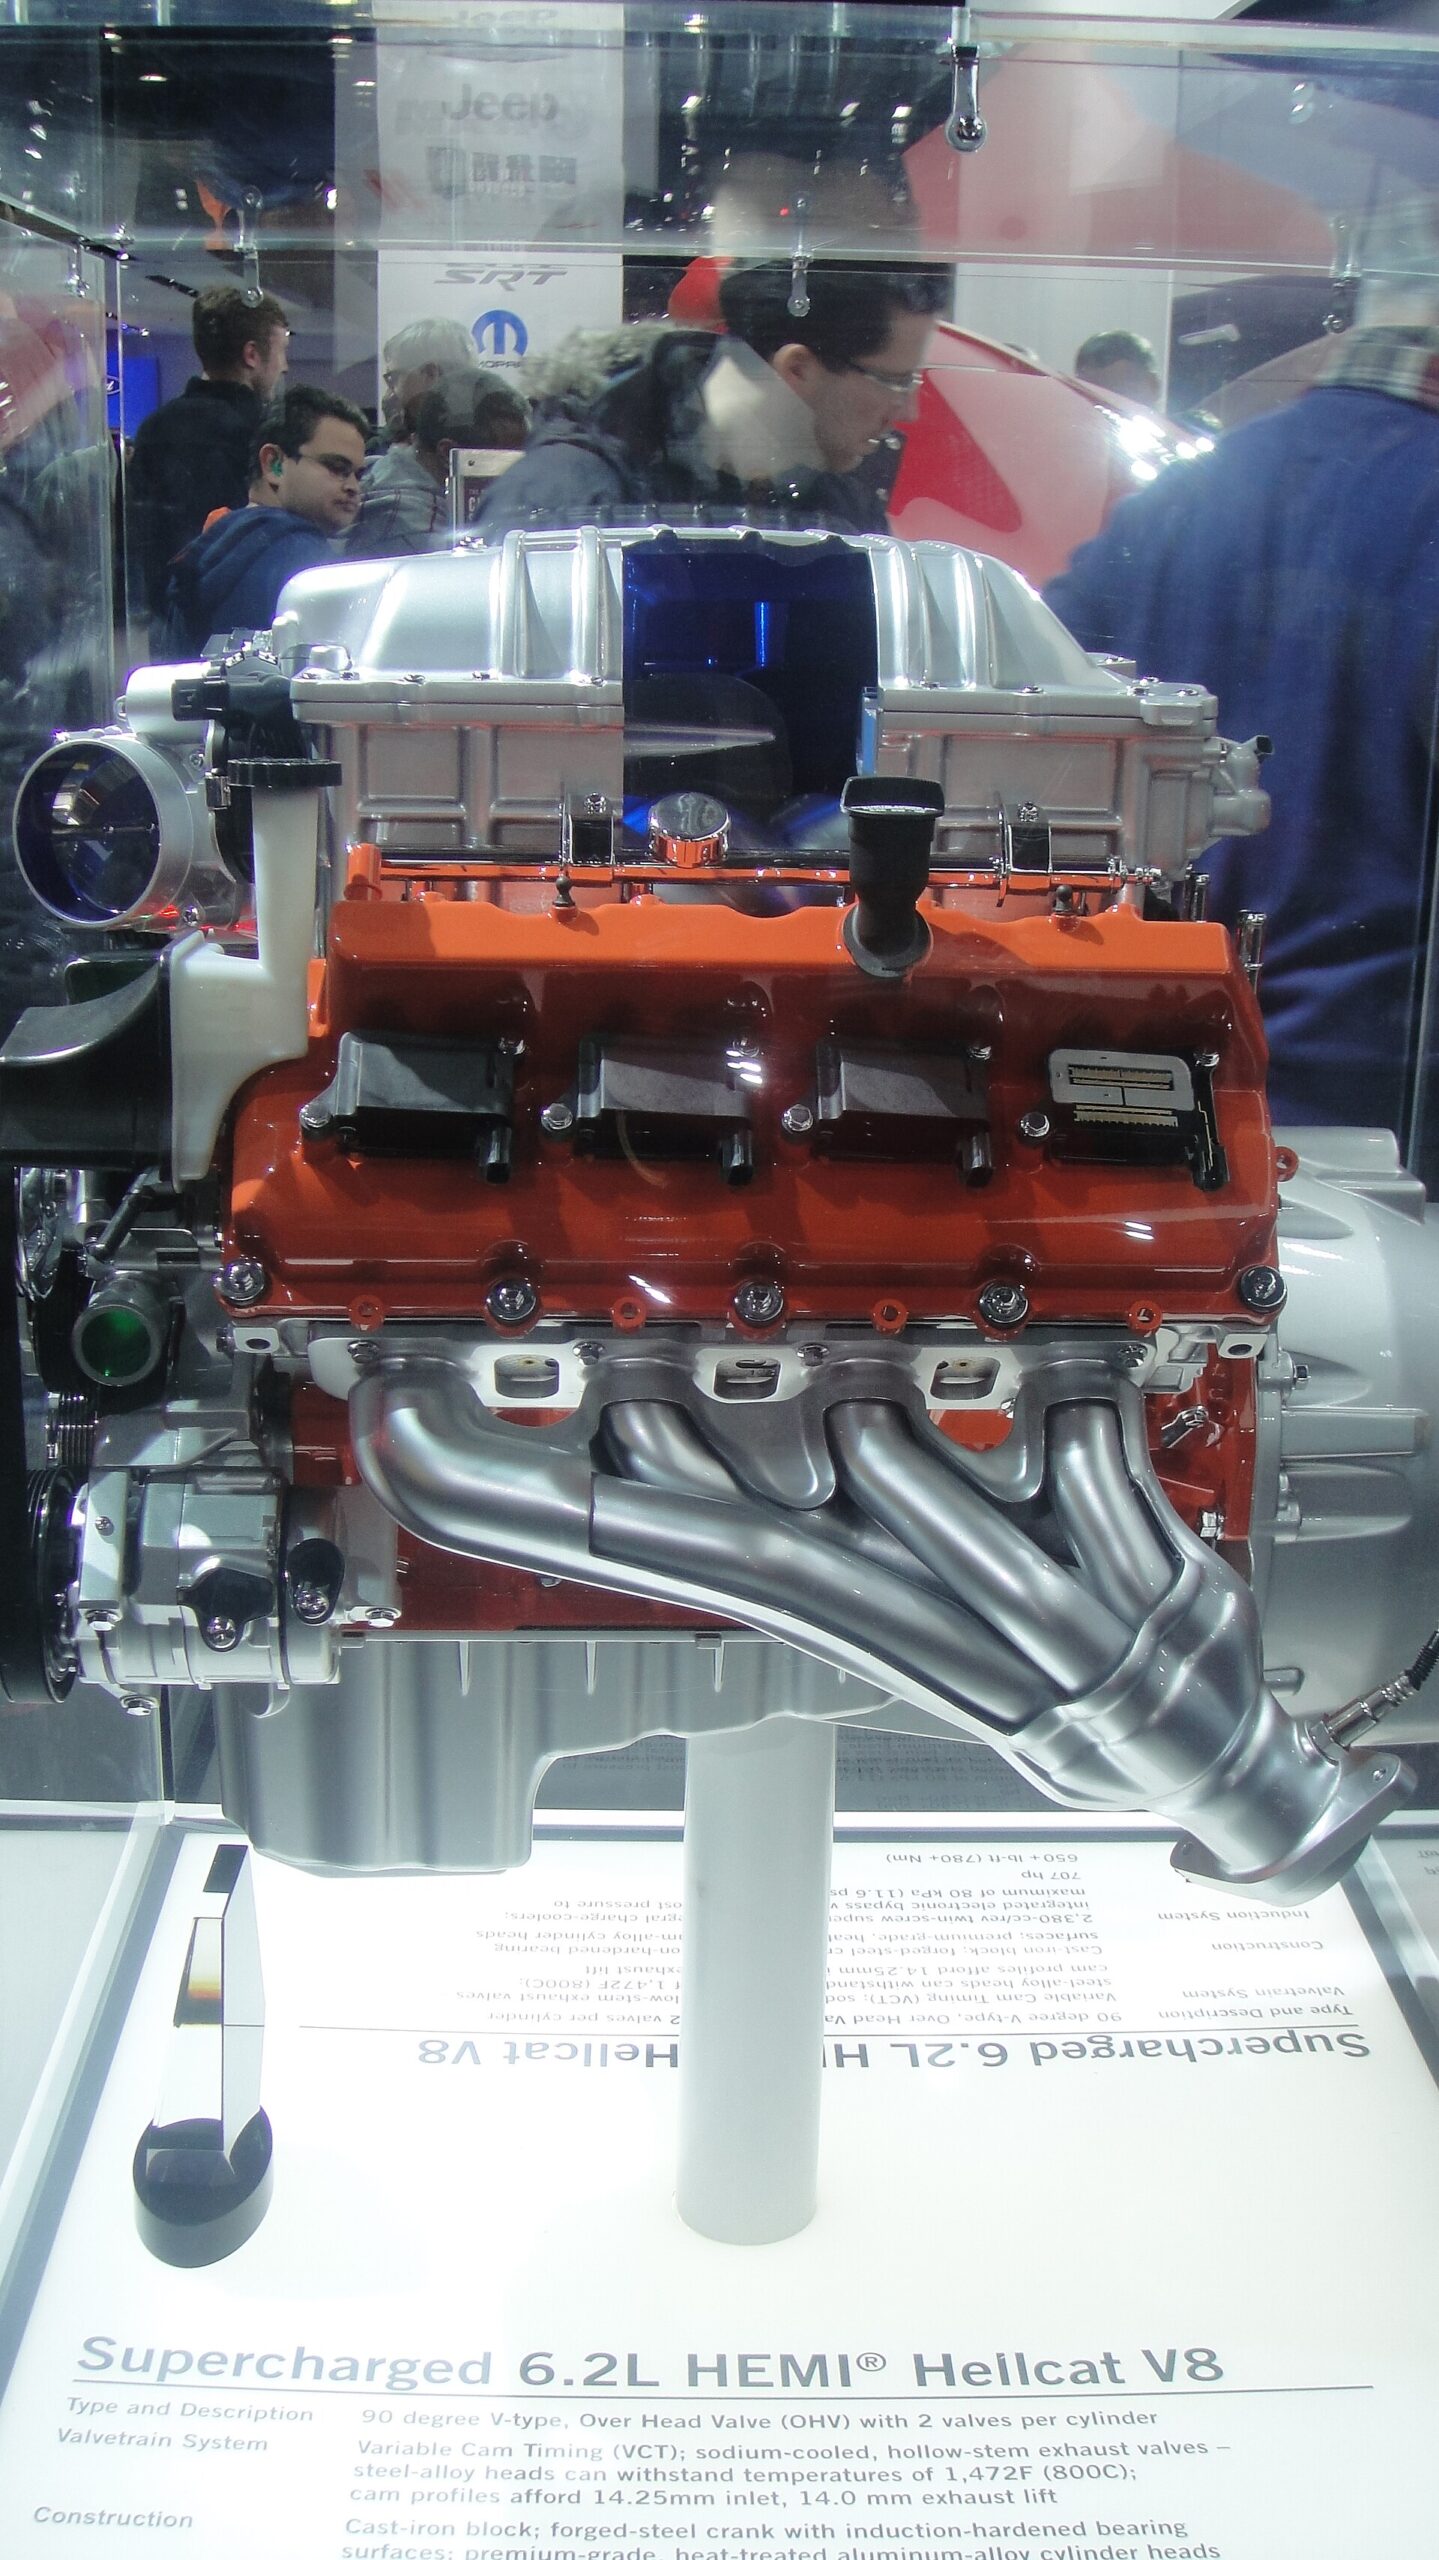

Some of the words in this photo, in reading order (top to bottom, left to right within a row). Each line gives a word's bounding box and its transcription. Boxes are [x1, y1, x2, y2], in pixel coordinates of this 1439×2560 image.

[441, 83, 559, 128] Jeep
[434, 269, 568, 291] SRT
[479, 359, 521, 368] OPA
[885, 1853, 922, 1864] Nm)
[1030, 1853, 1079, 1863] 650+
[1020, 1869, 1044, 1880] hp
[1050, 1870, 1081, 1880] 707
[911, 1889, 942, 1898] kPa
[949, 1889, 972, 1898] 80
[980, 1889, 996, 1898] of
[1002, 1888, 1086, 1898] maximum
[553, 1900, 570, 1909] to
[577, 1899, 650, 1910] pressure
[844, 1900, 904, 1912] bypass
[911, 1901, 996, 1911] electronic
[1002, 1900, 1089, 1911] integrated
[881, 1914, 973, 1925] twin-screw
[1157, 1910, 1220, 1922] System
[1226, 1910, 1309, 1921] Induction
[475, 1930, 527, 1940] heads
[535, 1931, 606, 1942] cylinder
[494, 1943, 560, 1955] bearing
[851, 1944, 955, 1957] forged-steel
[1023, 1945, 1103, 1956] Cast-iron
[1210, 1940, 1323, 1953] Construction
[585, 1965, 608, 1975] lift
[937, 1965, 990, 1976] afford
[997, 1963, 1063, 1976] profiles
[1071, 1964, 1108, 1973] cam
[826, 1980, 914, 1990] withstand
[921, 1979, 953, 1988] can
[960, 1979, 1013, 1989] heads
[1021, 1977, 1112, 1990] steel-alloy
[456, 1991, 511, 2002] valves
[520, 1992, 590, 2003] exhaust
[1044, 1992, 1117, 2003] Variable
[1181, 1987, 1248, 1999] System
[1254, 1986, 1345, 1998] Valvetrain
[926, 1992, 989, 2004] Timing
[996, 1993, 1036, 2004] Cam
[1157, 2007, 1263, 2021] Description
[1268, 2006, 1304, 2018] and
[1309, 2004, 1353, 2016] Type
[487, 2011, 562, 2022] cylinder
[570, 2012, 598, 2023] per
[606, 2014, 662, 2024] valves
[853, 2014, 901, 2024] Head
[909, 2014, 950, 2024] Over
[1028, 2011, 1088, 2022] degree
[1096, 2012, 1122, 2022] 90
[418, 2039, 482, 2066] V8
[1029, 2030, 1371, 2067] Supercharged
[502, 2041, 679, 2069] Hellcat
[889, 2041, 1009, 2068] 6.2L
[75, 2335, 494, 2391] Supercharged
[519, 2351, 661, 2388] 6.2L
[912, 2350, 1127, 2388] Hellcat
[1140, 2347, 1225, 2384] V8
[66, 2396, 118, 2417] Type
[127, 2402, 171, 2416] and
[180, 2403, 313, 2423] Description
[362, 2409, 393, 2424] 90
[403, 2410, 480, 2429] degree
[490, 2412, 570, 2431] V-type,
[579, 2413, 632, 2429] Over
[641, 2413, 702, 2429] Head
[711, 2413, 772, 2429] Valve
[780, 2413, 851, 2431] (OHV)
[859, 2413, 909, 2429] with
[917, 2413, 934, 2429] 2
[941, 2412, 1013, 2429] valves
[1020, 2414, 1058, 2431] per
[1065, 2409, 1159, 2429] cylinder
[58, 2427, 172, 2448] Valvetrain
[182, 2433, 268, 2453] System
[358, 2439, 452, 2457] Variable
[461, 2442, 513, 2458] Cam
[522, 2442, 603, 2462] Timing
[613, 2443, 686, 2463] (VCT);
[695, 2444, 878, 2463] sodium-cooled,
[887, 2442, 1030, 2459] hollow-stem
[1037, 2441, 1129, 2457] exhaust
[1136, 2439, 1210, 2455] valves
[354, 2463, 475, 2483] steel-alloy
[485, 2465, 555, 2481] heads
[564, 2470, 607, 2482] can
[616, 2466, 735, 2483] withstand
[742, 2467, 904, 2487] temperatures
[911, 2466, 935, 2483] of
[944, 2465, 1033, 2485] 1,472F
[1043, 2463, 1137, 2483] (800C);
[350, 2489, 400, 2502] cam
[410, 2487, 500, 2505] profiles
[510, 2488, 581, 2505] afford
[594, 2489, 716, 2507] 14.25mm
[725, 2489, 789, 2509] inlet,
[799, 2489, 857, 2507] 14.0
[866, 2491, 914, 2505] mm
[921, 2489, 1014, 2505] exhaust
[1021, 2487, 1059, 2503] lift
[33, 2506, 193, 2529] Construction
[345, 2518, 455, 2536] Cast-iron
[466, 2520, 541, 2541] block;
[549, 2521, 696, 2543] forged-steel
[706, 2522, 776, 2540] crank
[783, 2522, 836, 2540] with
[845, 2520, 1088, 2540] induction-hardened
[1095, 2518, 1190, 2539] bearing
[1146, 2542, 1223, 2560] heads
